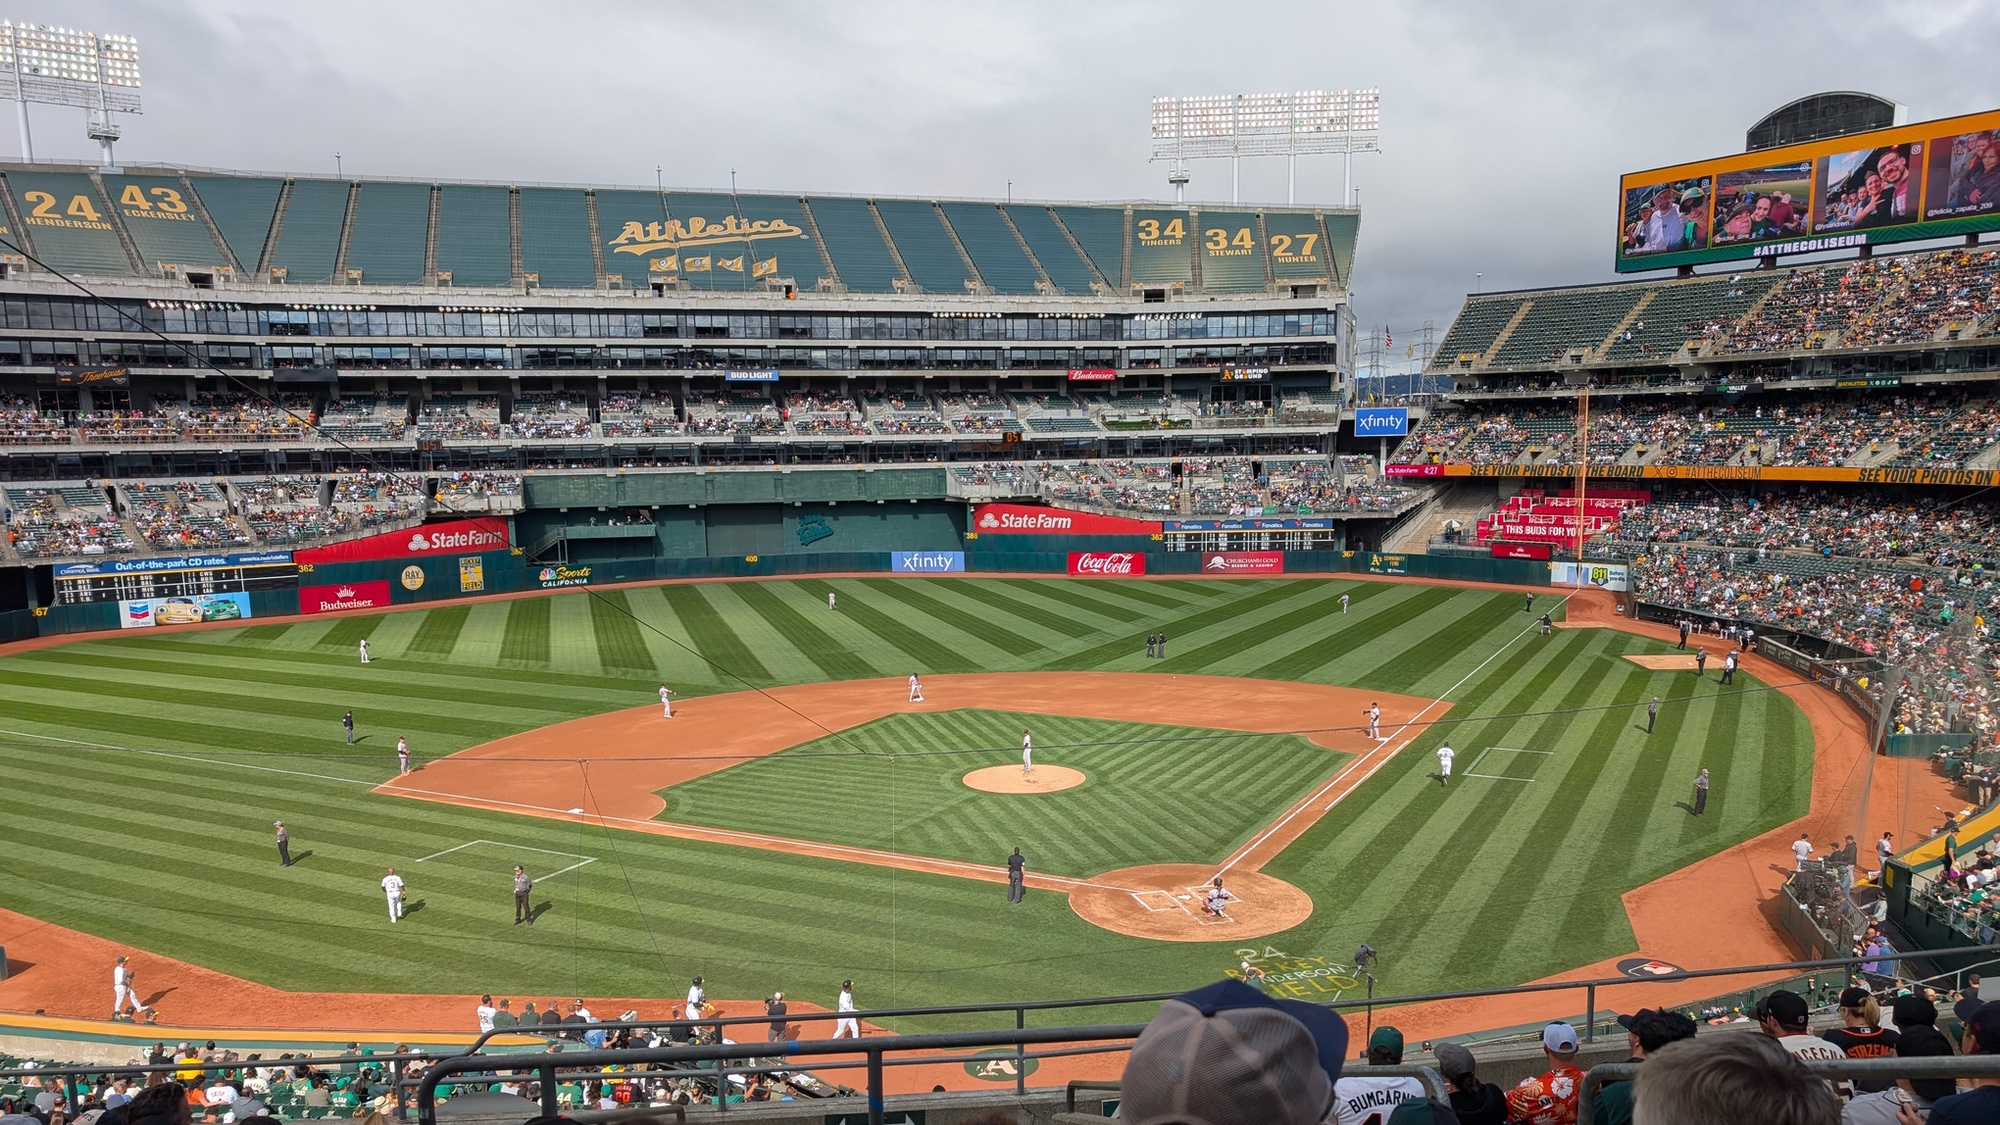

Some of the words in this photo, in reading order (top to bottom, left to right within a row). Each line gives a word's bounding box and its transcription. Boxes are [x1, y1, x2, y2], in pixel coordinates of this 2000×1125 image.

[24, 191, 102, 221] 24
[120, 186, 188, 213] 43
[124, 209, 195, 222] ECKERSLEY
[26, 217, 112, 231] HENDERSON
[1138, 218, 1186, 239] 34
[609, 215, 803, 252] Athletics
[1205, 228, 1255, 249] 34
[1141, 239, 1182, 247] FINGERS
[1271, 234, 1319, 256] 27
[1753, 234, 1866, 257] #ATTHECOLISEUM
[77, 368, 127, 385] Treehouse
[731, 371, 748, 380] BUD
[749, 371, 773, 380] LIGHT
[1071, 370, 1115, 380] Budweiser
[1360, 413, 1403, 430] xfinity
[1424, 467, 1438, 475] 4:27
[1470, 465, 1490, 476] SEE
[1490, 465, 1519, 476] YOUR
[1522, 465, 1564, 477] PHOTOS
[1586, 466, 1606, 477] THE
[1607, 466, 1644, 478] BOARD
[1858, 468, 1880, 482] SEE
[1880, 469, 1916, 483] YOUR
[1920, 469, 1972, 484] PHOTOS
[1975, 470, 1994, 485] ON
[1000, 513, 1072, 529] StateFarm
[1506, 525, 1524, 535] THIS
[1525, 525, 1547, 535] BUDS
[1548, 526, 1565, 536] FOR
[431, 529, 503, 549] StateFarm
[115, 558, 188, 571] Out-of-the-park
[188, 558, 202, 567] CD
[203, 556, 228, 566] rates.
[745, 555, 759, 563] 400
[903, 553, 954, 572] xfinity
[1077, 553, 1135, 574] Coca-Cola
[298, 564, 314, 574] 362
[405, 569, 420, 580] RAY
[556, 566, 592, 580] Sports
[1592, 567, 1607, 580] 811
[462, 581, 483, 590] FIELD
[542, 578, 588, 588] CALIFORNIA
[1234, 945, 1289, 963] 24
[1348, 1090, 1417, 1114] BUMGARN
